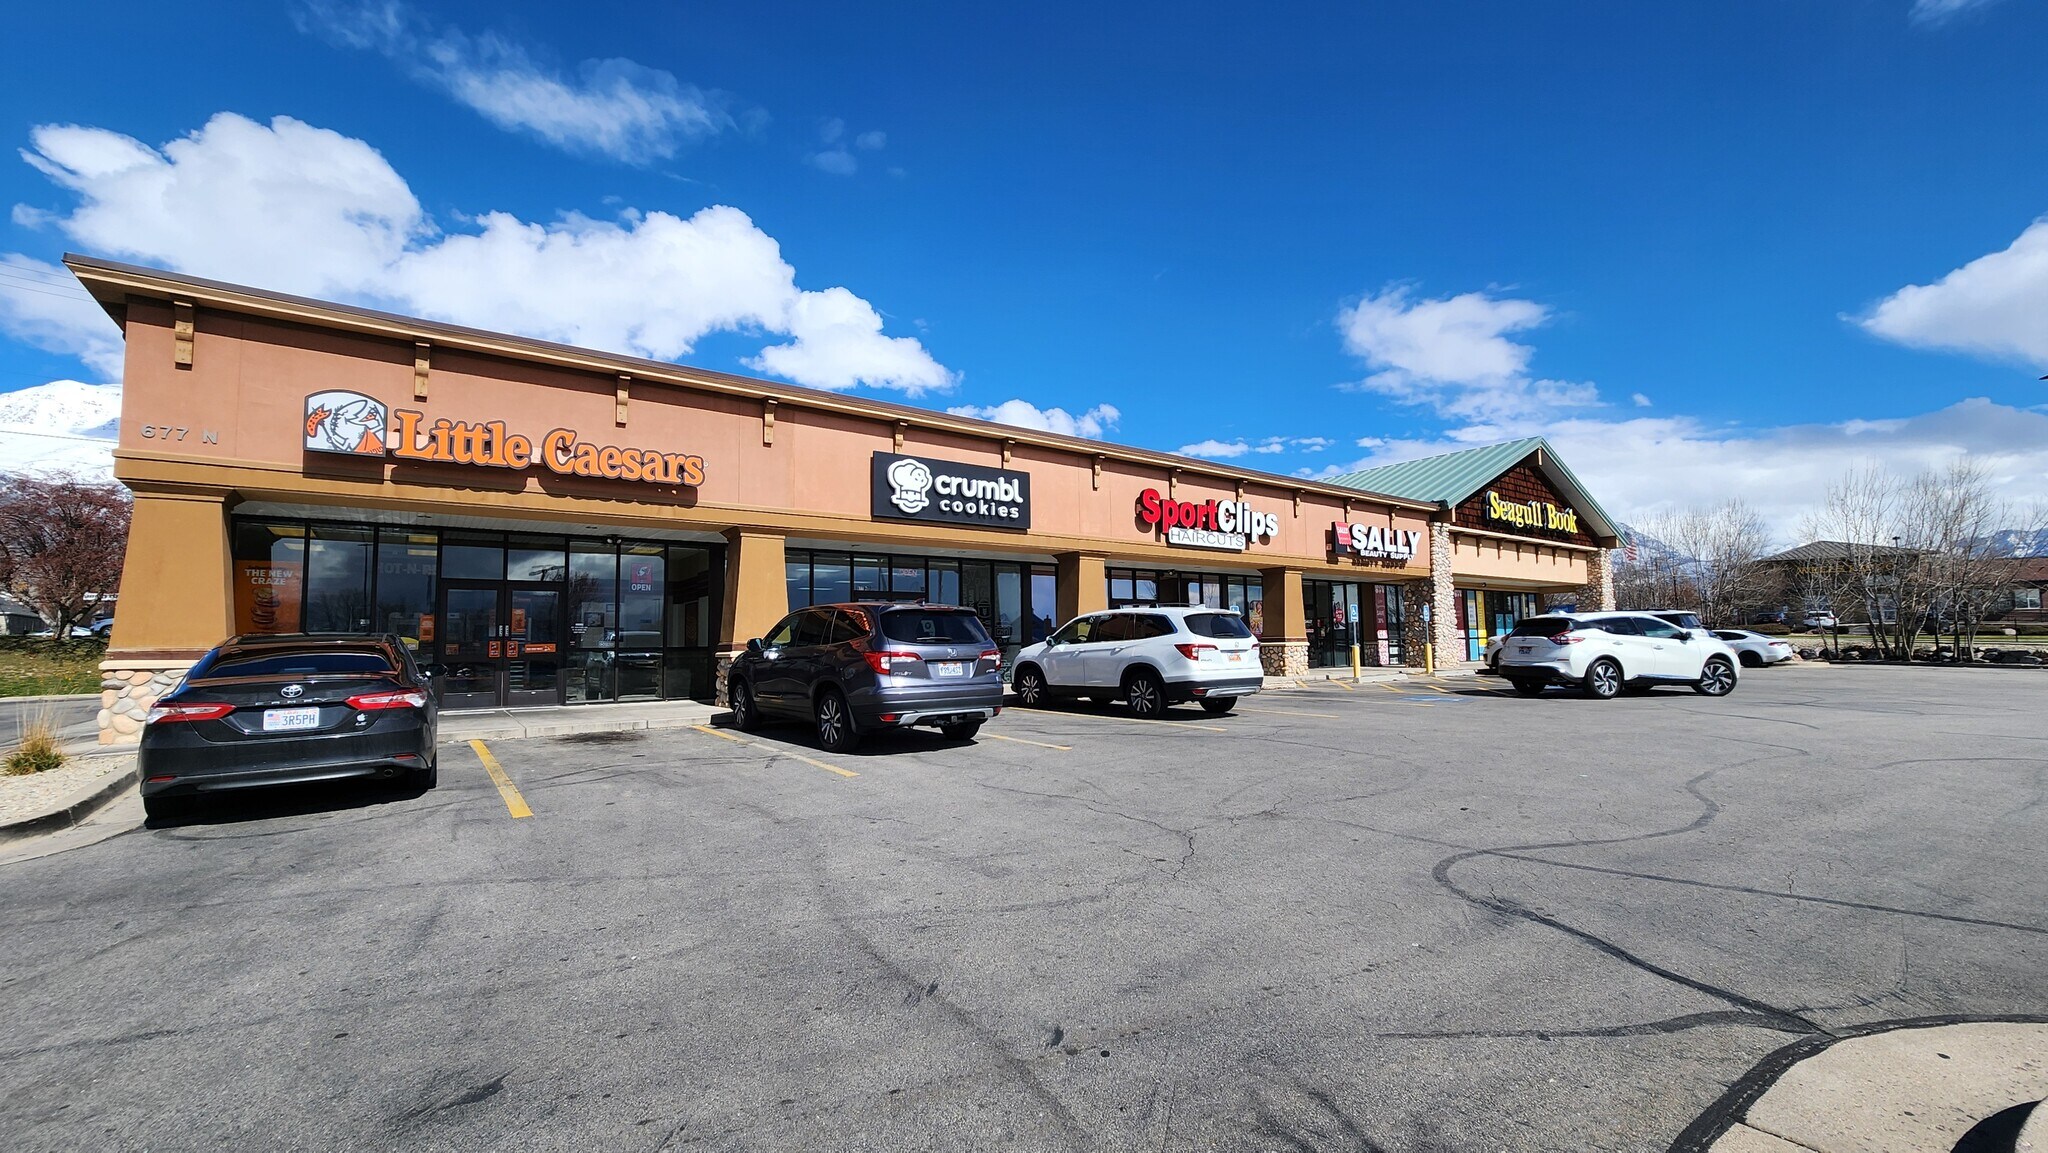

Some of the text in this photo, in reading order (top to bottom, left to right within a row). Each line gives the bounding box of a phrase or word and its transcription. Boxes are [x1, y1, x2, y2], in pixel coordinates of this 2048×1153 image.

[141, 425, 219, 445] 677 N
[394, 409, 705, 487] Little Caesars
[934, 474, 1024, 504] crumbl
[939, 500, 1020, 519] cookies
[1488, 491, 1578, 534] Seagull Book
[1170, 529, 1245, 547] HAIRCUTS
[1351, 523, 1422, 554] SALLY
[1360, 549, 1415, 561] BEAUTY SUPPLY
[245, 568, 294, 578] THE NEW
[251, 577, 287, 586] CRAZE
[631, 583, 652, 591] OPEN
[282, 714, 316, 726] 3R5PH
